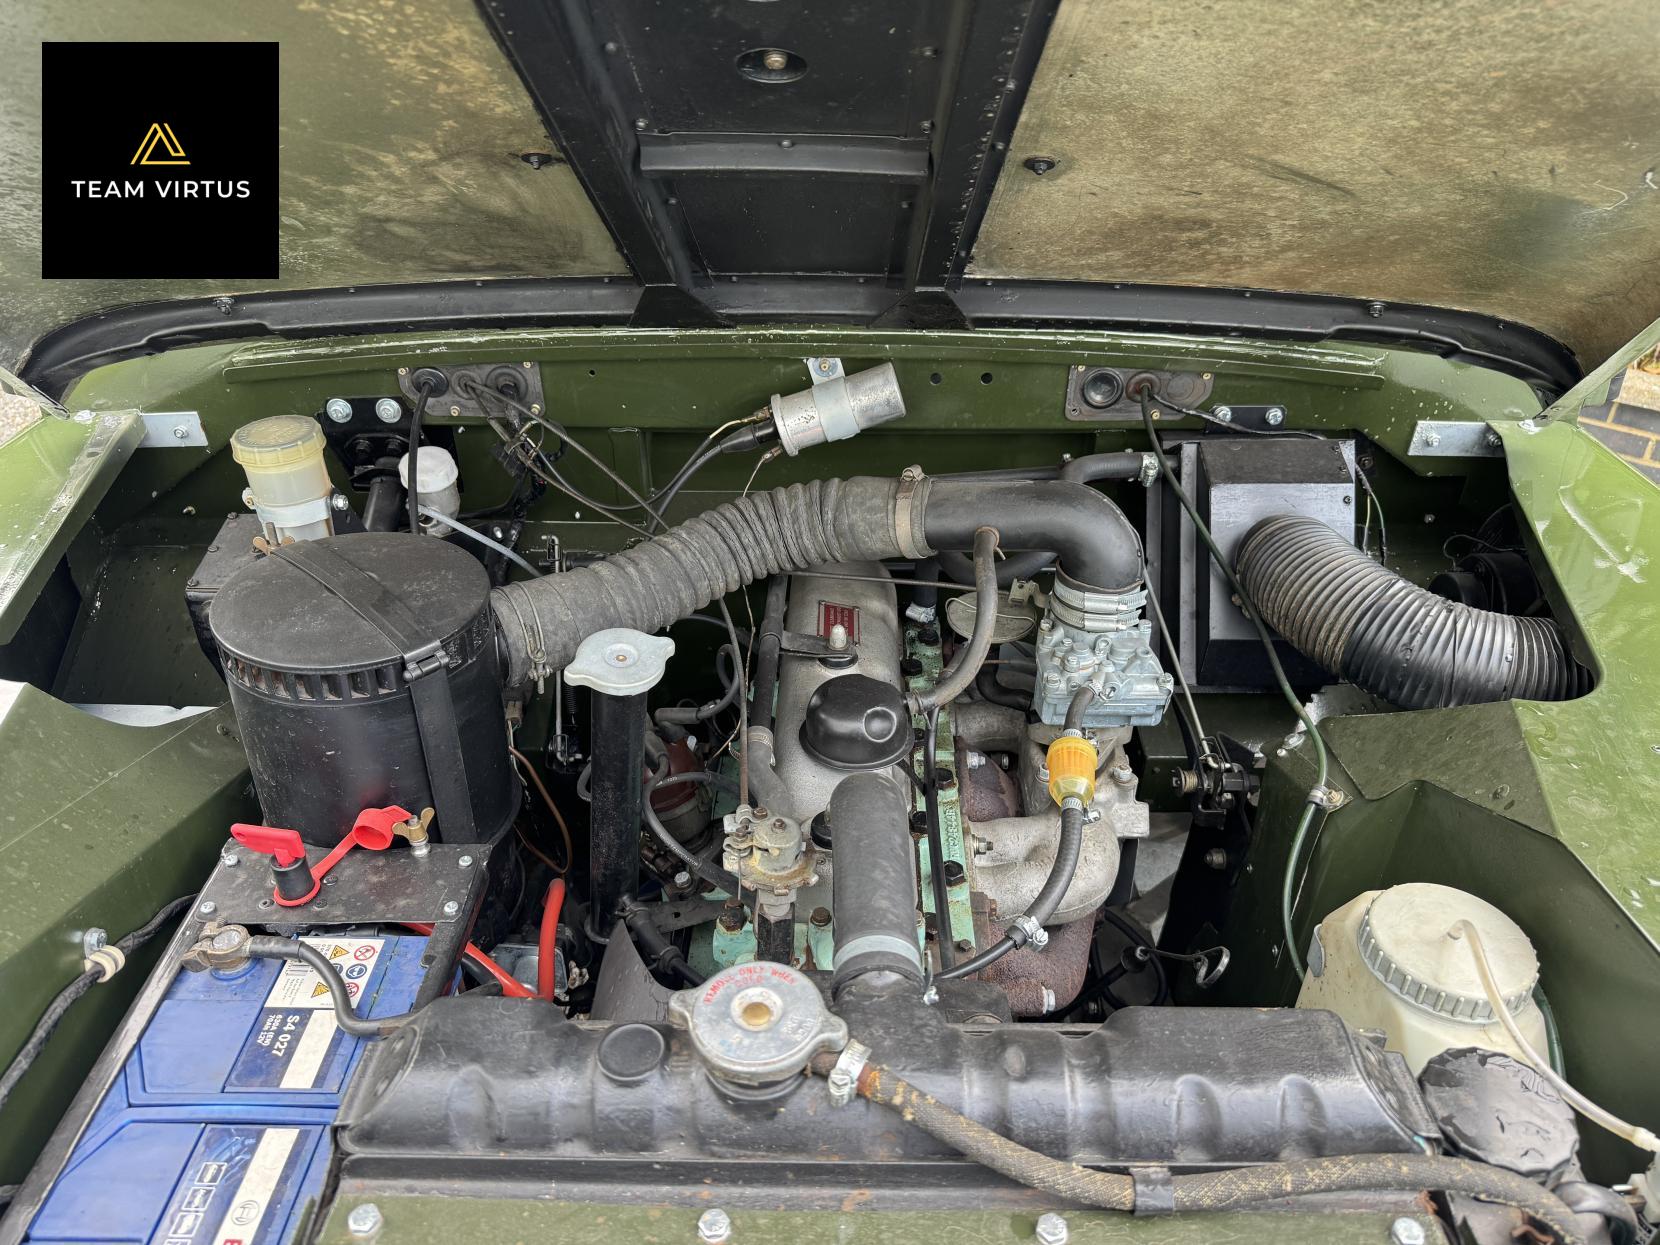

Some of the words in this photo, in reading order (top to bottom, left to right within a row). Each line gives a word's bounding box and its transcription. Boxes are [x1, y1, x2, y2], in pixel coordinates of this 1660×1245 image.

[703, 975, 736, 1005] REMOVE
[738, 965, 765, 976] ONLY
[770, 967, 798, 985] WHEN
[282, 1014, 300, 1031] S4
[271, 1033, 292, 1057] 027
